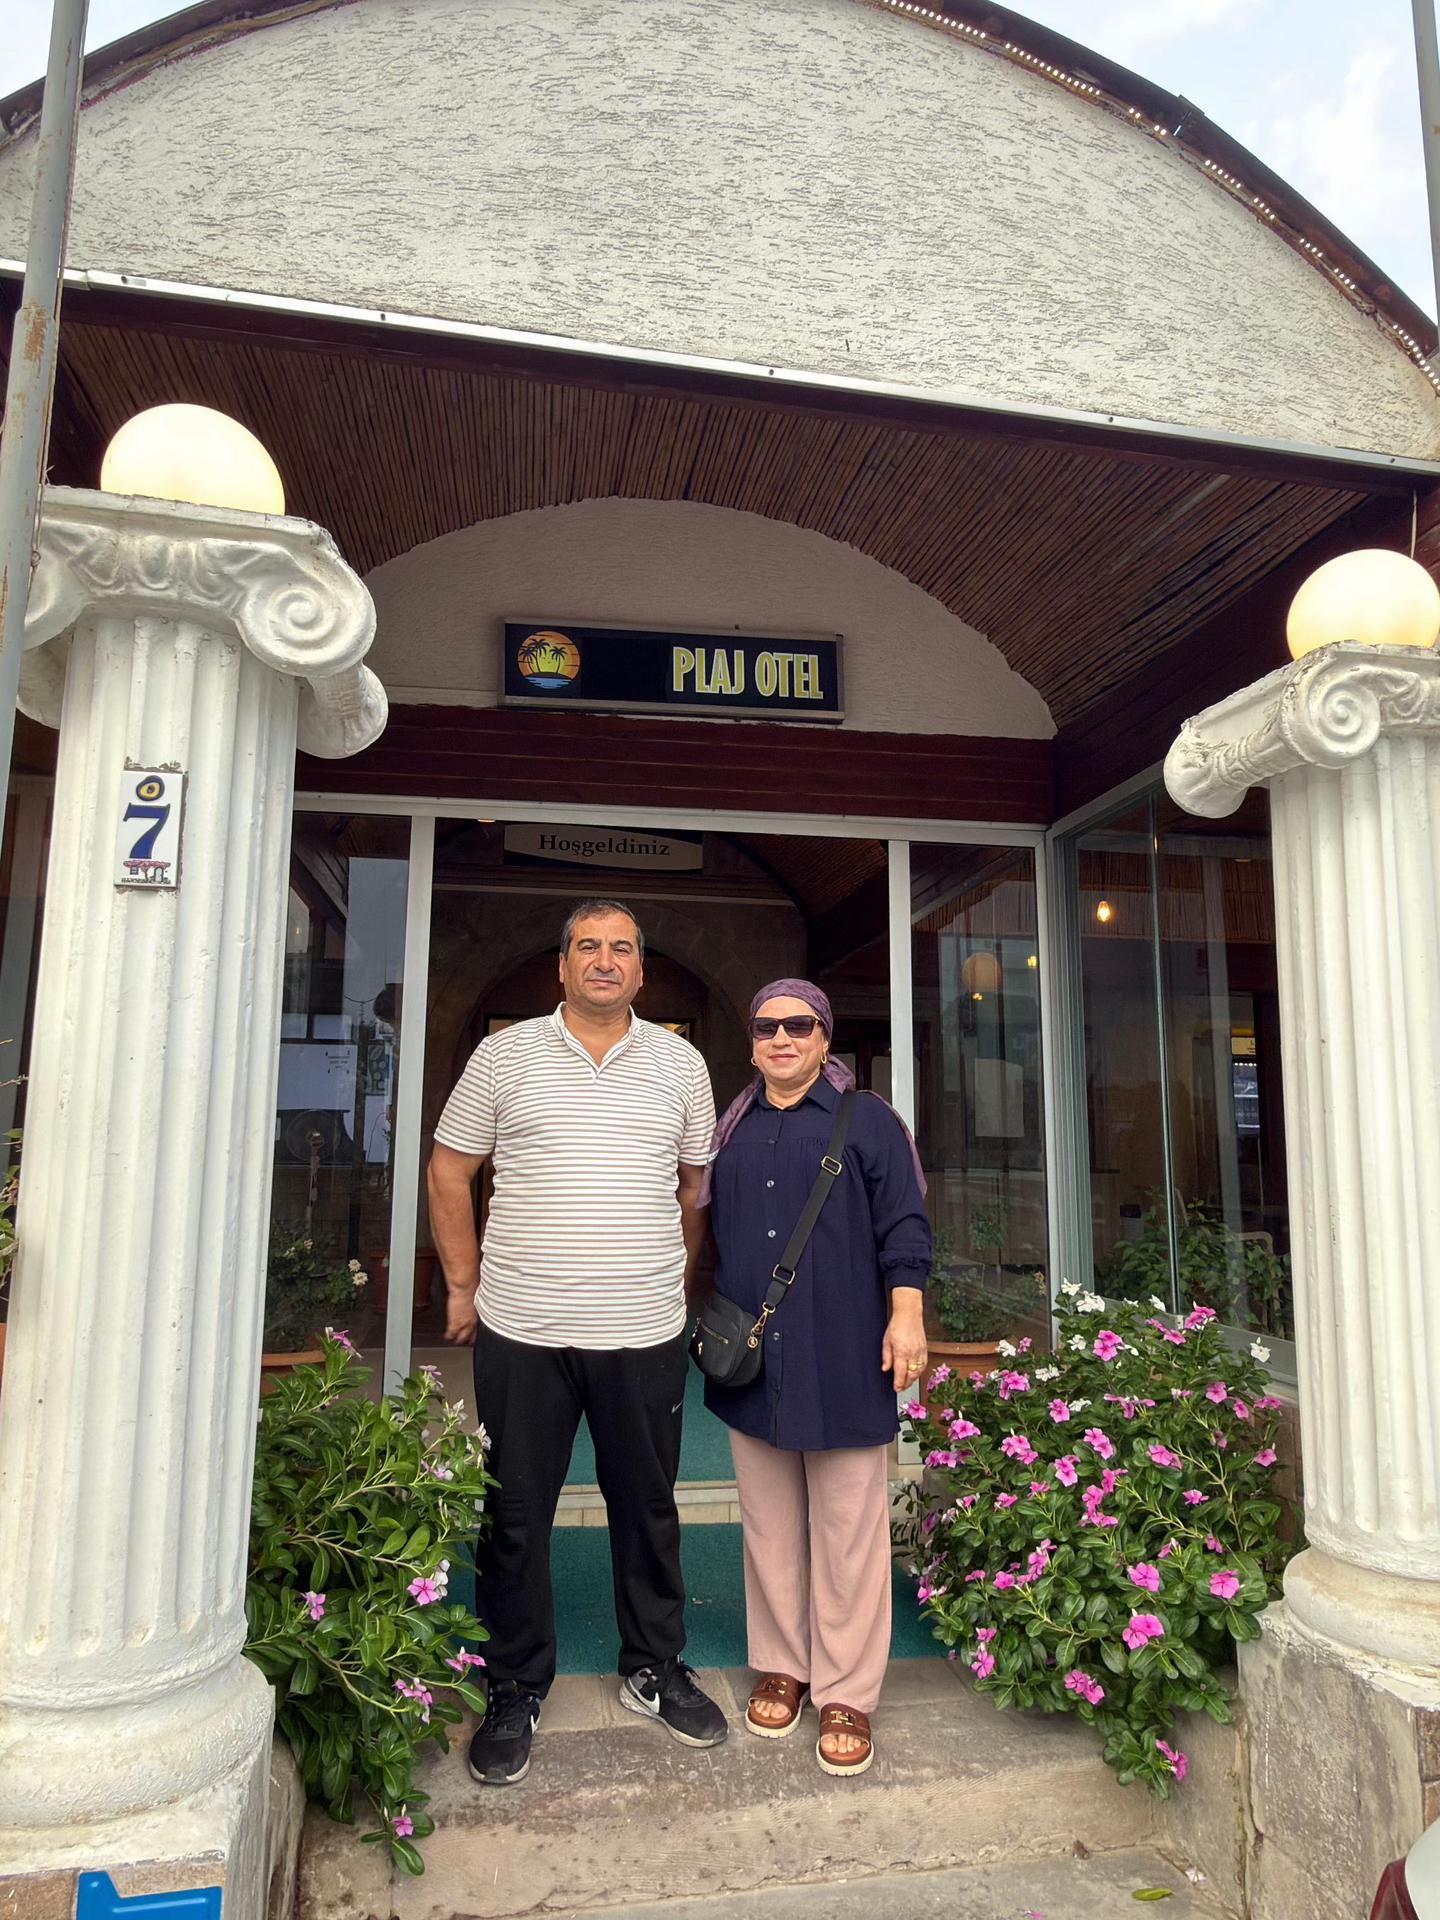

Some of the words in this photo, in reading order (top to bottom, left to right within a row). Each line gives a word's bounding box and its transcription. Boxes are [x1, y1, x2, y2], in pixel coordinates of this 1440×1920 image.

[672, 646, 745, 695] PLAJ
[755, 651, 824, 699] OTEL
[123, 802, 171, 859] 7
[539, 834, 670, 857] Hoşgeldiniz
